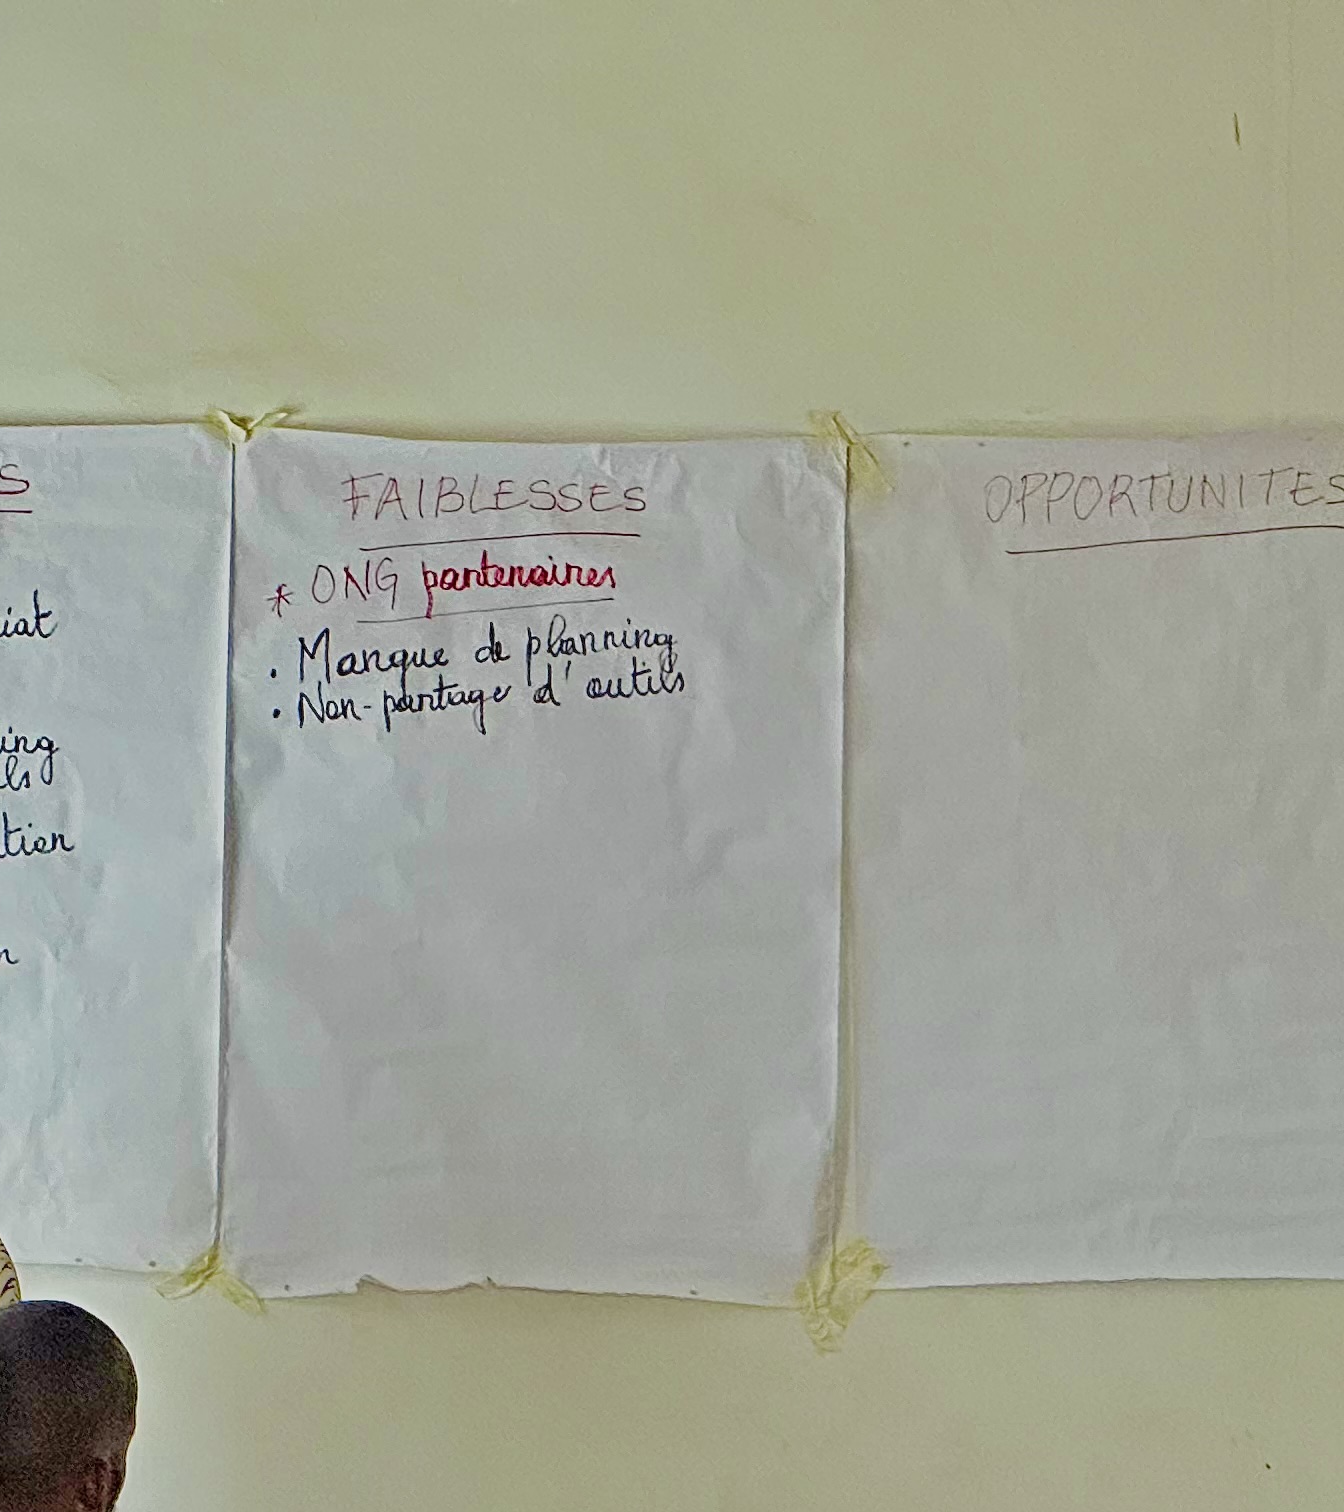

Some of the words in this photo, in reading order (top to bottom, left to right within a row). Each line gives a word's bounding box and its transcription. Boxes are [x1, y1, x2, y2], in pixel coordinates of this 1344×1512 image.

[341, 472, 647, 521] FAIBLESSES
[311, 557, 398, 609] ONG
[422, 549, 617, 619] partenaires
[299, 628, 450, 685] Manque
[474, 622, 510, 662] de
[526, 615, 677, 687] planning
